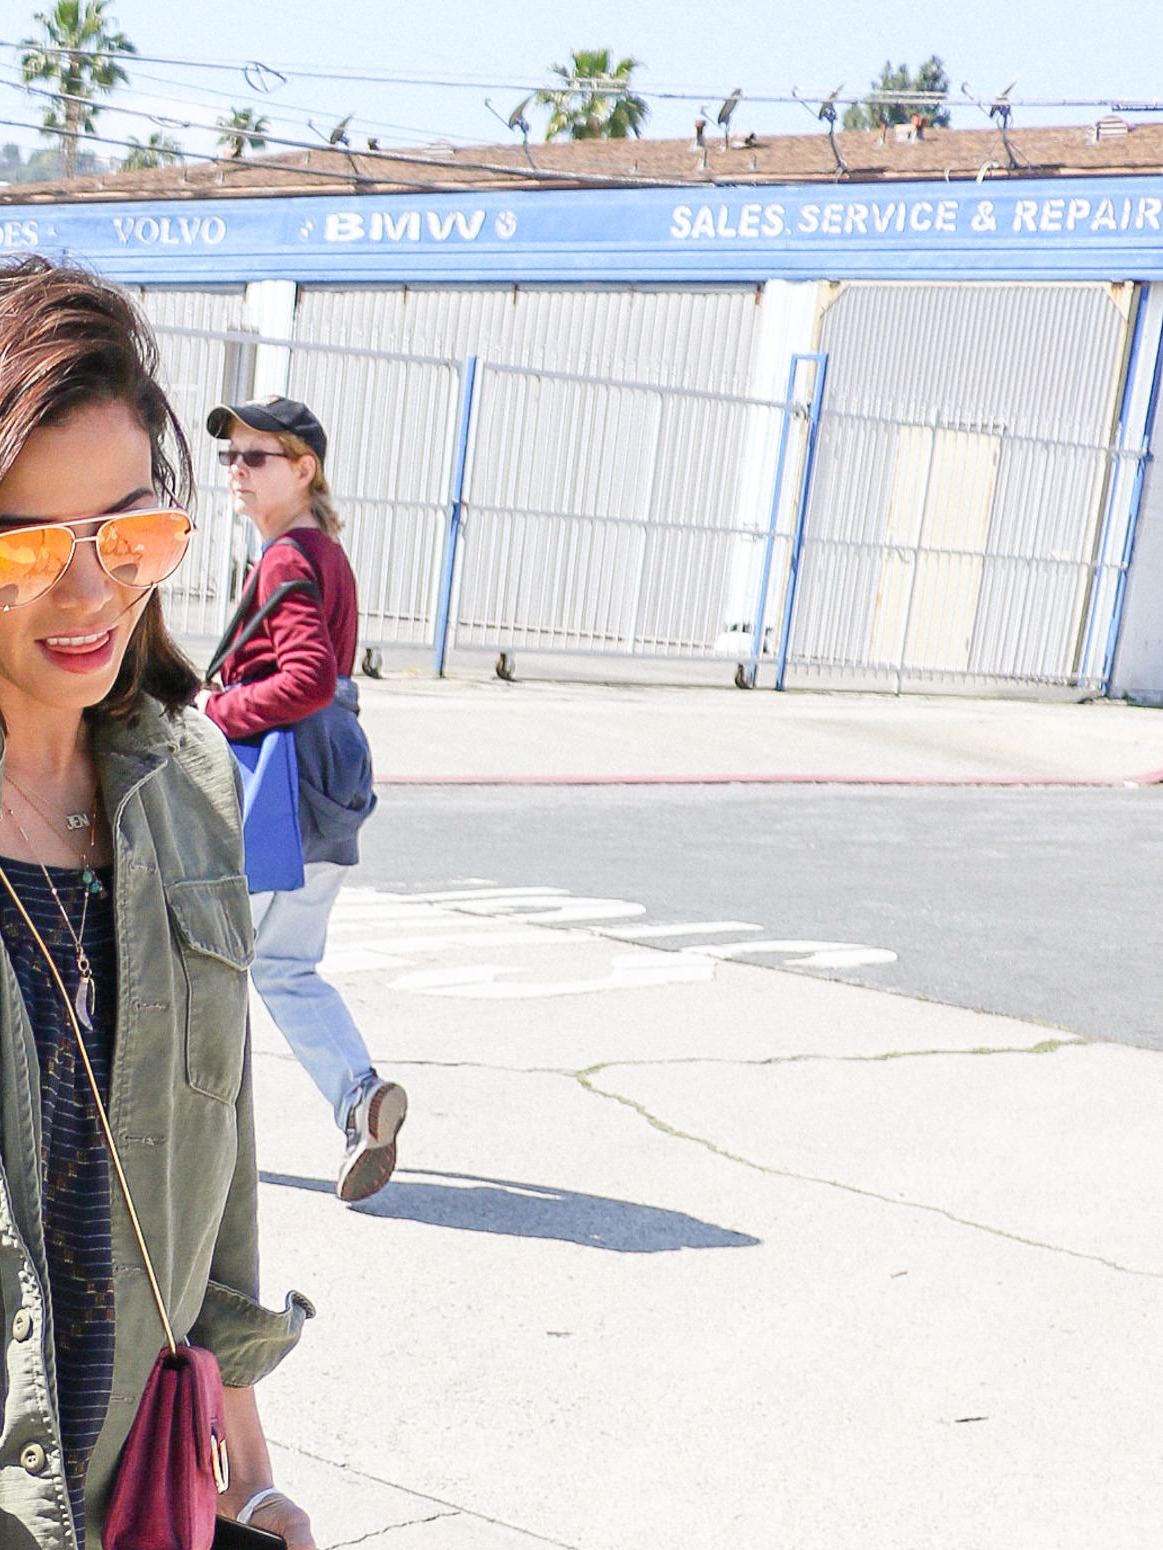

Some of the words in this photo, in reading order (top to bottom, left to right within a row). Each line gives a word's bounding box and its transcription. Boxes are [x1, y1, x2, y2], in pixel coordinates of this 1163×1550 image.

[113, 216, 227, 245] VOLVO
[324, 209, 487, 242] BMW
[797, 201, 959, 234] SERVICE
[970, 201, 998, 233] &
[1012, 197, 1163, 233] REPAIR
[66, 813, 91, 830] JEN
